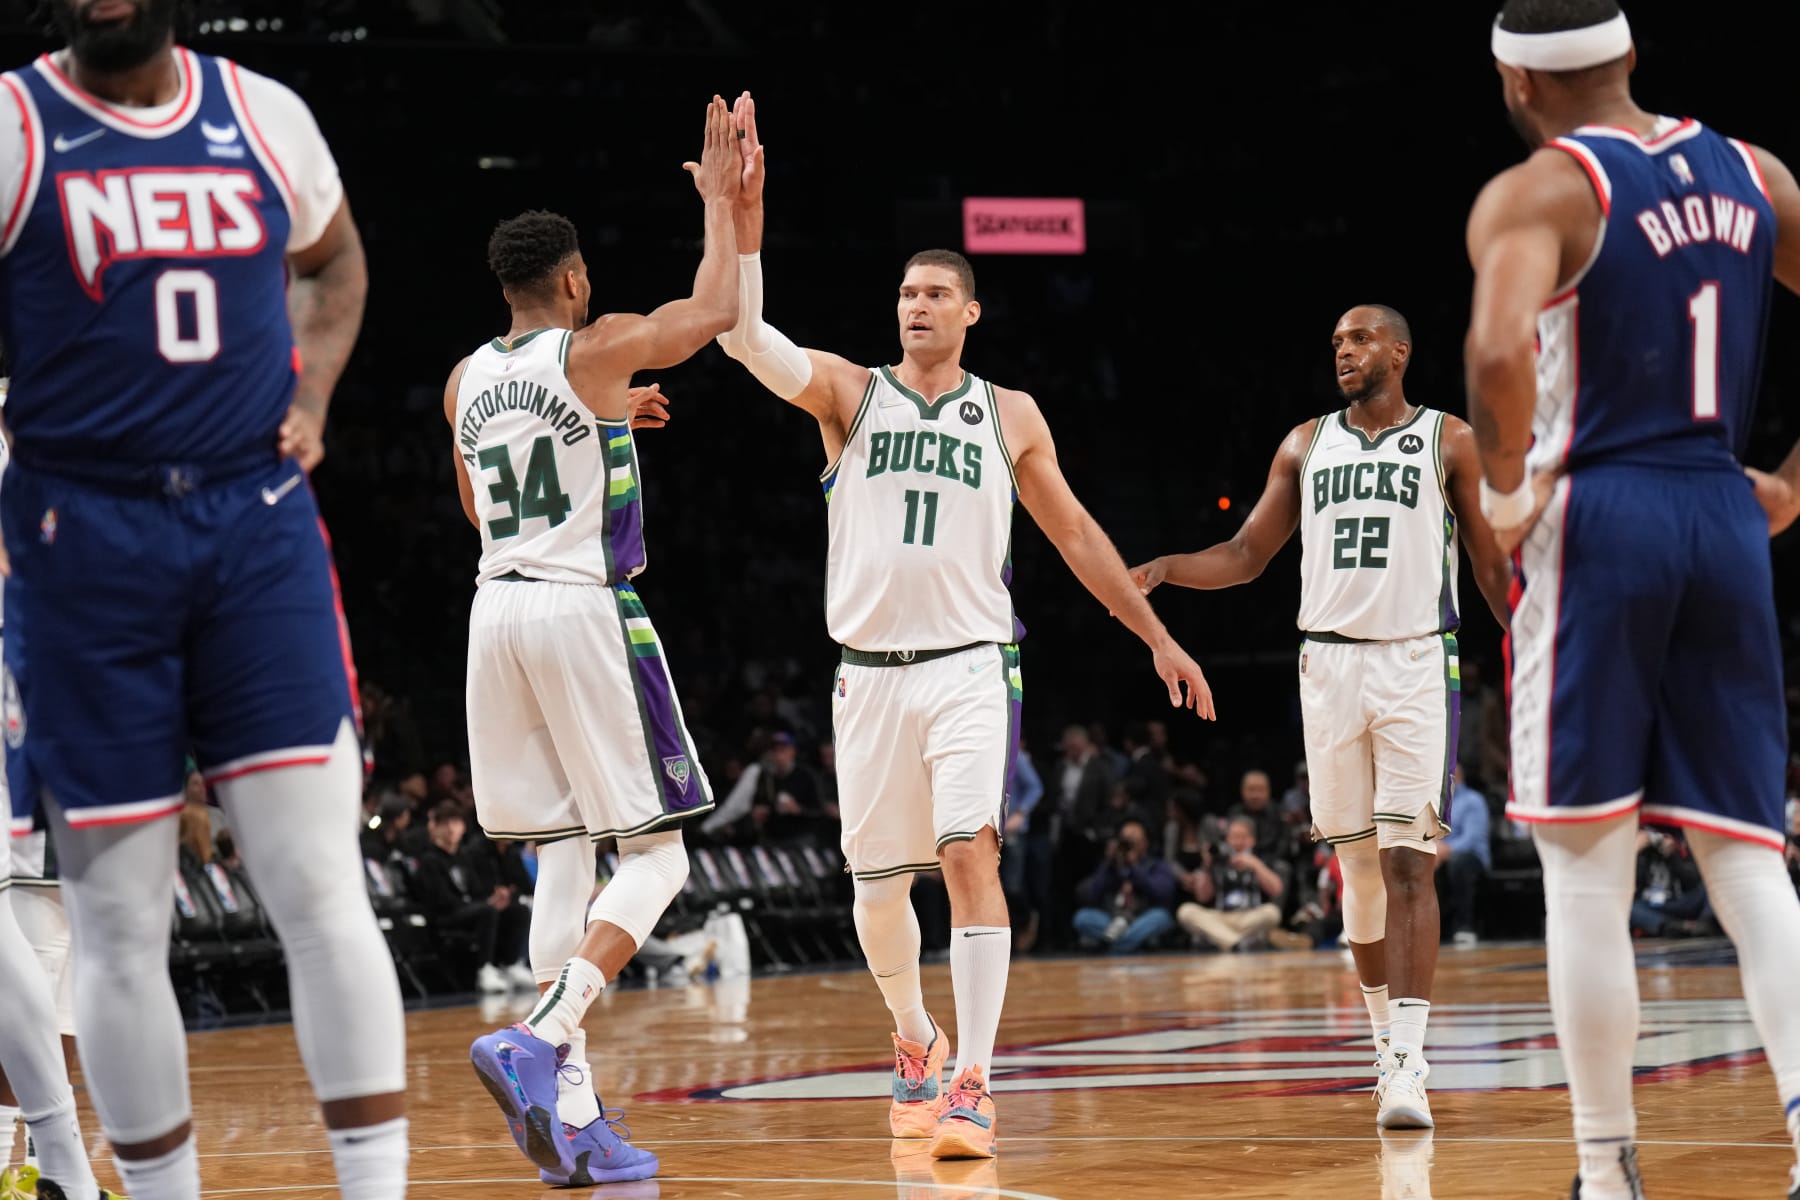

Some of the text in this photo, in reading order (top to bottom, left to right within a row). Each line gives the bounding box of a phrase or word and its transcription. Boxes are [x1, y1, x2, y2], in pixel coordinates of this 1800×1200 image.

[56, 166, 267, 302] NETS
[1637, 194, 1757, 257] BROWN
[155, 268, 221, 364] 0
[1688, 282, 1720, 421] 1
[461, 381, 591, 466] ANTETOKOUNMPO
[866, 430, 983, 490] BUCKS
[477, 435, 572, 540] 34
[902, 489, 939, 546] 11
[1312, 461, 1422, 515] BUCKS
[1333, 516, 1390, 570] 22
